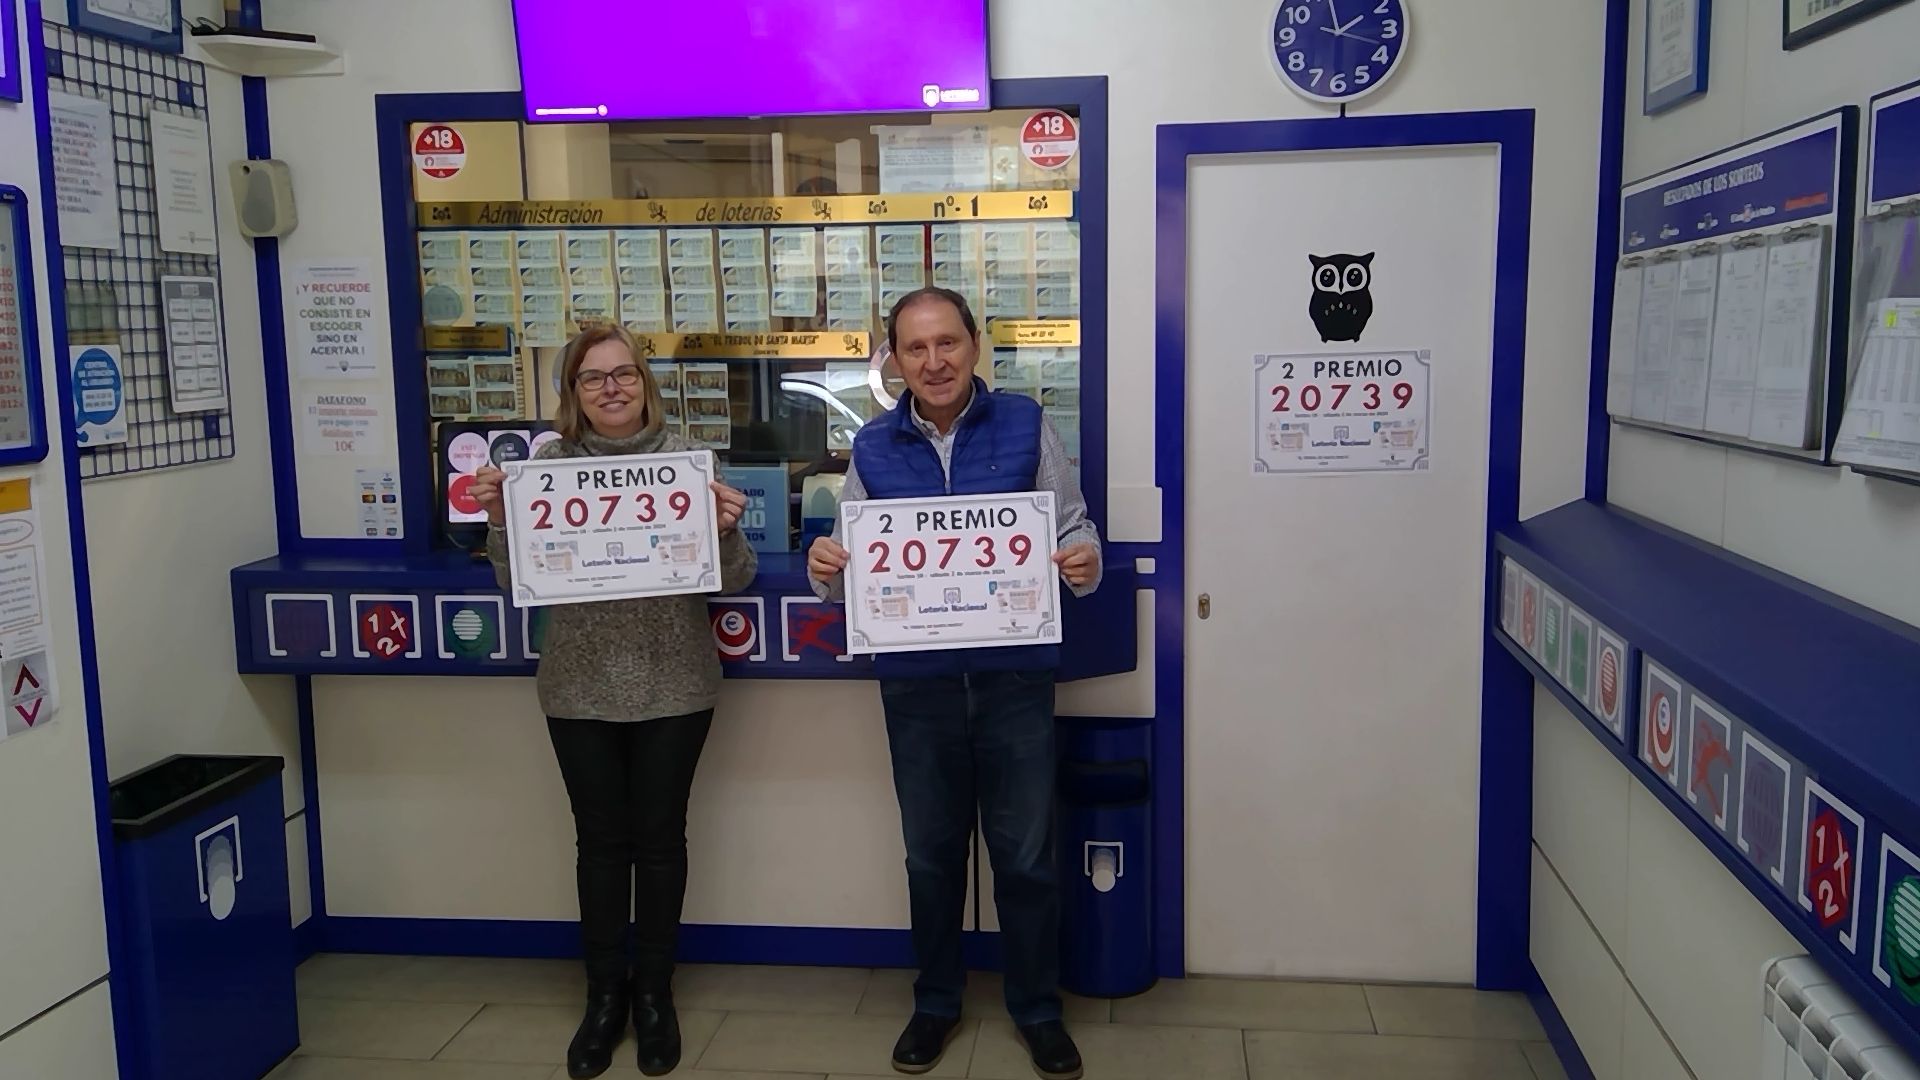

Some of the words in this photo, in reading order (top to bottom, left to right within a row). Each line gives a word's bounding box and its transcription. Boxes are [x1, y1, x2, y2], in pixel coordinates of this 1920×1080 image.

[1285, 5, 1311, 24] 10
[1279, 27, 1296, 47] 9
[1381, 19, 1398, 39] 3
[1288, 51, 1305, 71] 8
[1371, 45, 1389, 65] 4
[1309, 68, 1324, 87] 7
[1329, 73, 1347, 93] 6
[1354, 65, 1370, 84] 5
[1032, 115, 1065, 135] +18
[423, 129, 454, 148] +18
[696, 202, 716, 221] de
[970, 195, 979, 217] 1
[311, 283, 371, 293] RECUERDE
[313, 296, 336, 306] QUE
[339, 296, 356, 306] NO
[299, 309, 353, 319] CONSISTE
[356, 309, 371, 318] EN
[310, 321, 363, 332] ESCOGER
[316, 334, 341, 343] SINO
[343, 334, 358, 343] EN
[310, 346, 360, 355] ACERTAR
[1281, 362, 1295, 380] 2
[1314, 359, 1402, 378] PREMIO
[1271, 382, 1413, 413] 20739
[334, 440, 355, 451] 10€
[540, 473, 555, 492] 2
[577, 466, 676, 490] PREMIO
[530, 491, 691, 530] 20739
[879, 513, 893, 533] 2
[916, 507, 1018, 531] PREMIO
[868, 534, 1032, 573] 20739
[951, 602, 988, 612] Nacional
[368, 614, 379, 633] 1
[377, 636, 400, 656] 2
[1816, 825, 1826, 864] 1
[1818, 879, 1840, 919] 2
